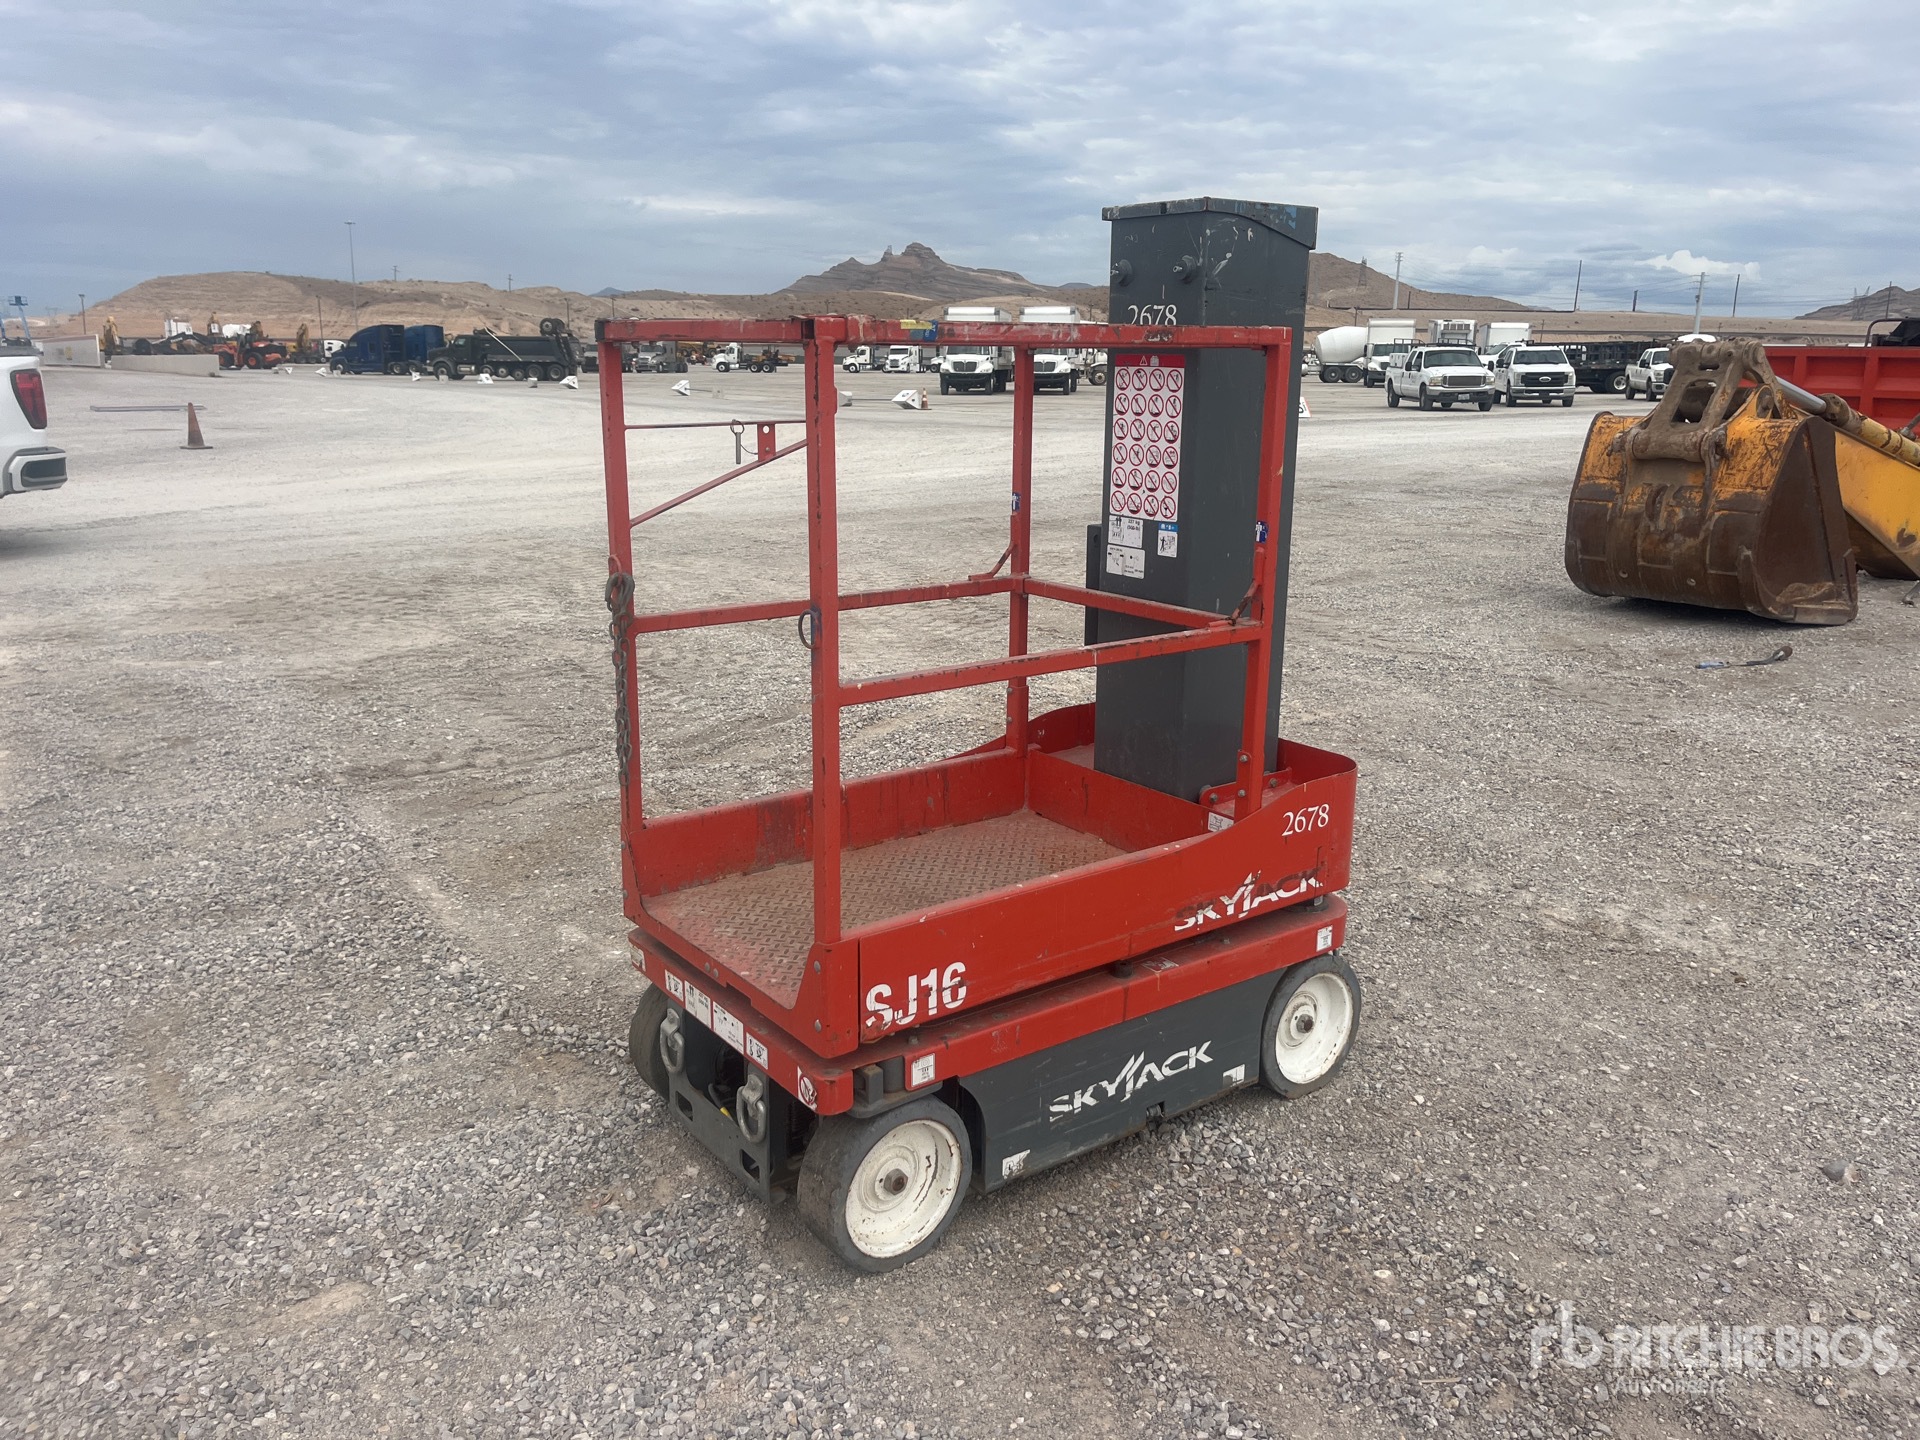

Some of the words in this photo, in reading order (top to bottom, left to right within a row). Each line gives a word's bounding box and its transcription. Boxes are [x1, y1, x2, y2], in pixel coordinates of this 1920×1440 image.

[1127, 304, 1177, 326] 2678
[1281, 804, 1330, 837] 2678
[1174, 868, 1323, 931] SKYJACK
[865, 961, 967, 1031] SJ16
[1049, 1040, 1214, 1123] SKYJACK
